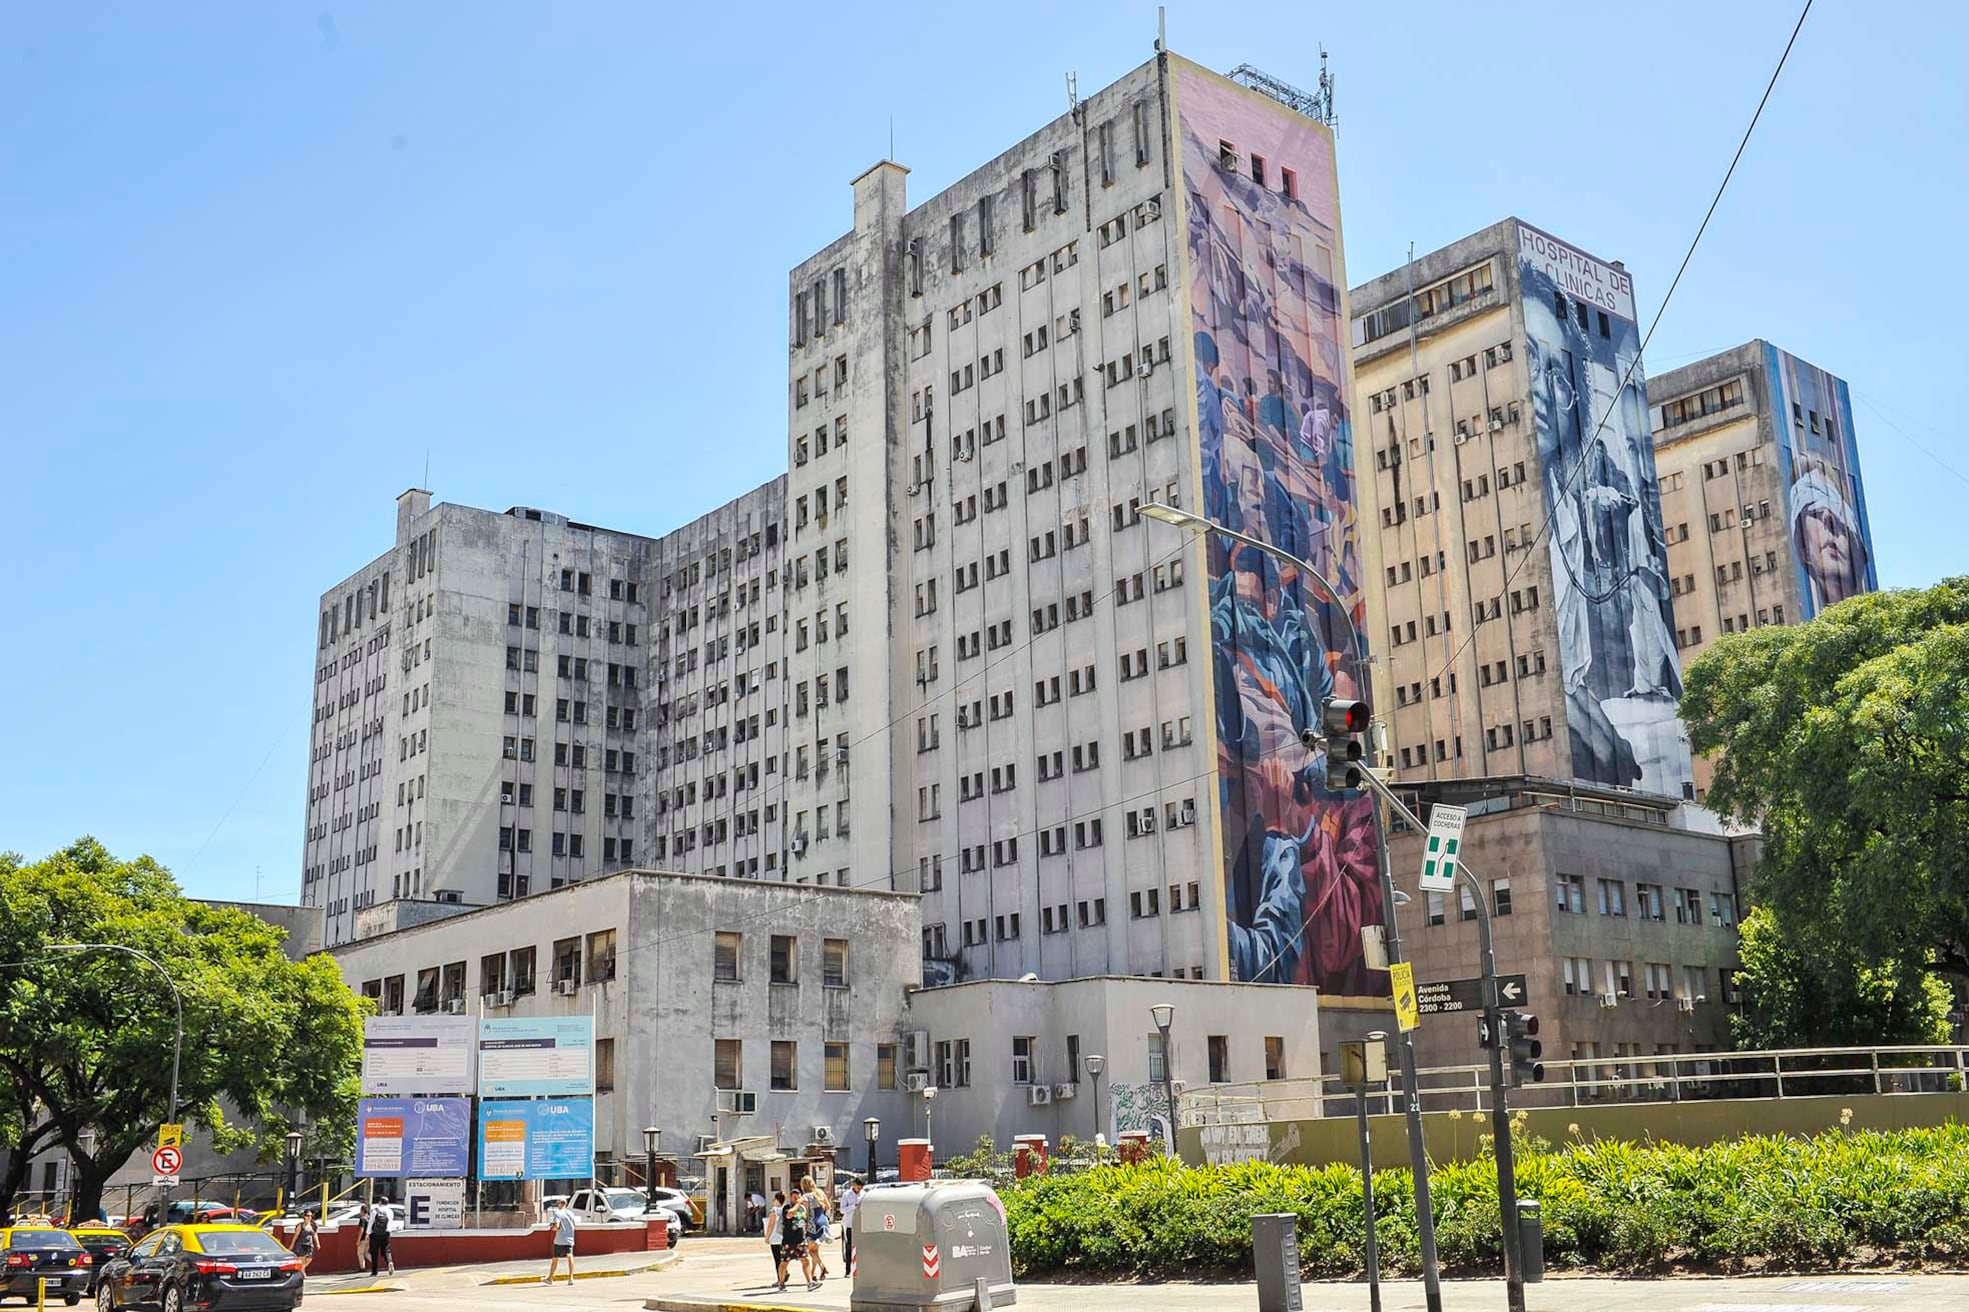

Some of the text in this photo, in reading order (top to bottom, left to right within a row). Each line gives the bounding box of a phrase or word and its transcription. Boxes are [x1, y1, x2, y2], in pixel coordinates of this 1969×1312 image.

[1521, 229, 1629, 296] HOSPITAL DE
[1436, 811, 1457, 822] ACCESO
[1433, 820, 1461, 829] COCHERAS
[1418, 984, 1449, 995] Avenida
[1418, 992, 1451, 1004] Córdoba
[1420, 1004, 1438, 1013] 2300
[1443, 1001, 1463, 1011] 2200
[426, 1104, 445, 1112] UBA
[550, 1105, 569, 1114] UBA
[410, 1195, 430, 1225] E
